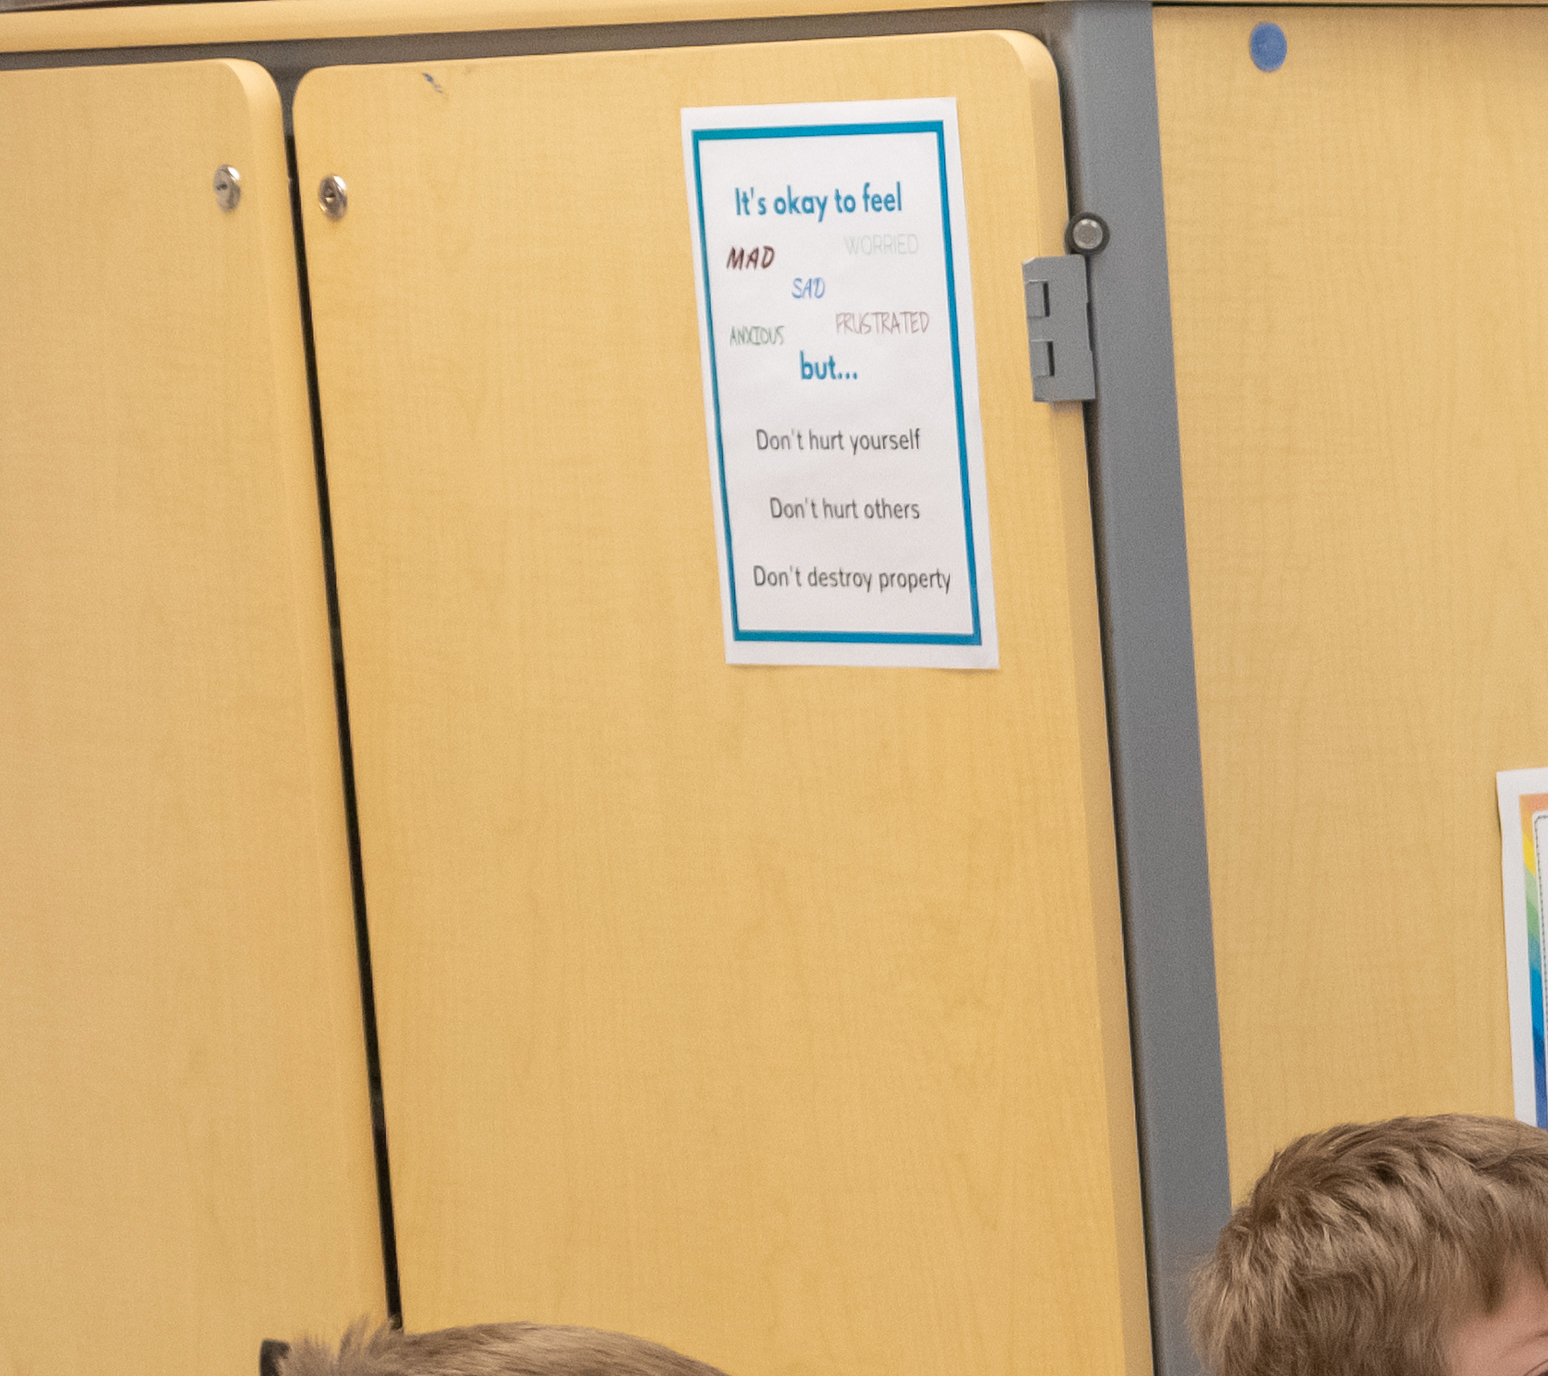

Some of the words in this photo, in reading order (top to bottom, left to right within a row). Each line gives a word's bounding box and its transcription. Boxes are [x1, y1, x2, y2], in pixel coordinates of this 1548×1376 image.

[735, 187, 766, 215] It's
[774, 185, 828, 222] okay
[835, 189, 855, 213] to
[863, 181, 902, 213] feel
[844, 234, 918, 256] WORRIED
[726, 246, 775, 270] MAD
[792, 277, 825, 299] SAD
[836, 311, 929, 335] FRUSTRATED
[730, 326, 784, 346] ANXIOUS
[800, 350, 857, 380] but...
[756, 428, 804, 450] Don't
[809, 428, 844, 450] hurt
[850, 428, 921, 455] yourself
[770, 497, 818, 519] Don't
[823, 498, 859, 519] hurt
[864, 498, 920, 519] others
[753, 565, 801, 587] Don't
[807, 567, 872, 593] destroy
[879, 568, 951, 595] property
